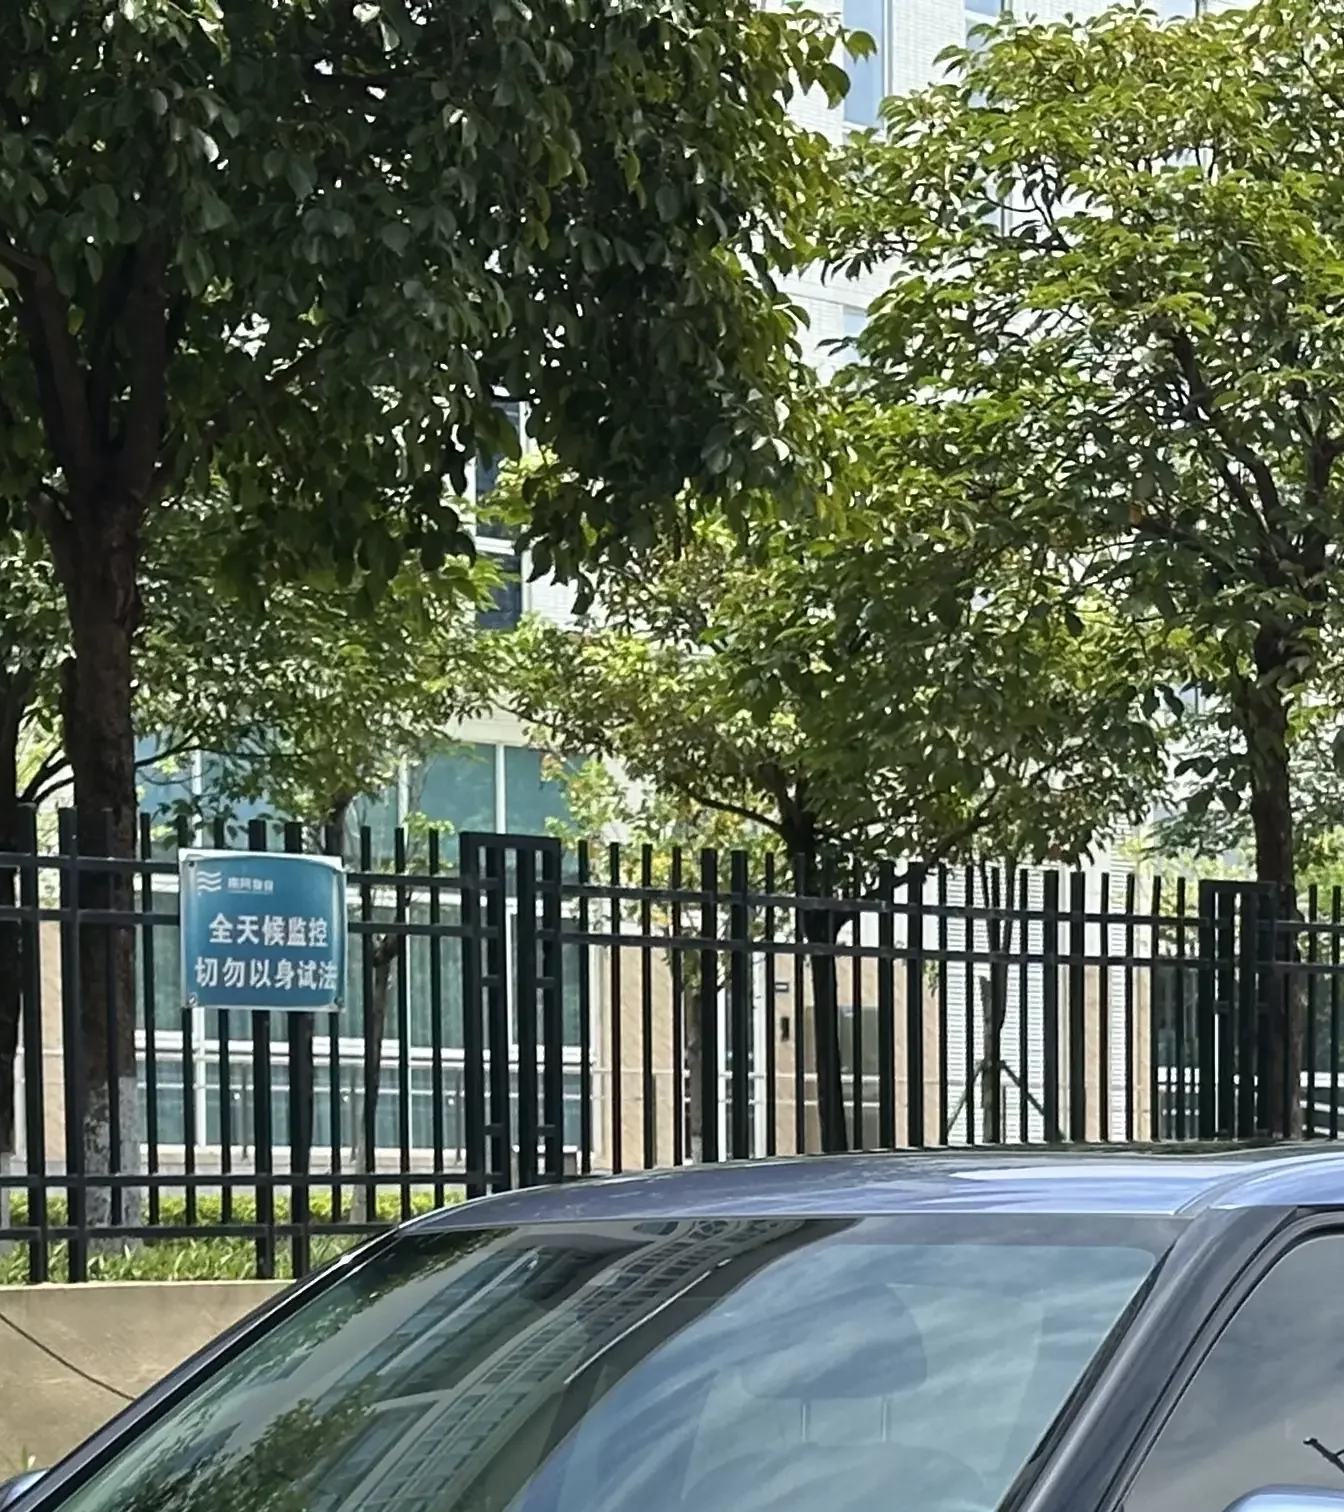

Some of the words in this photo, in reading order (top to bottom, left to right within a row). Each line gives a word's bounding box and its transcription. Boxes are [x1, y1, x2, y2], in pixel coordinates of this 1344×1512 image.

[209, 912, 328, 947] 全天候监控
[194, 956, 338, 990] 切勿以身试法
